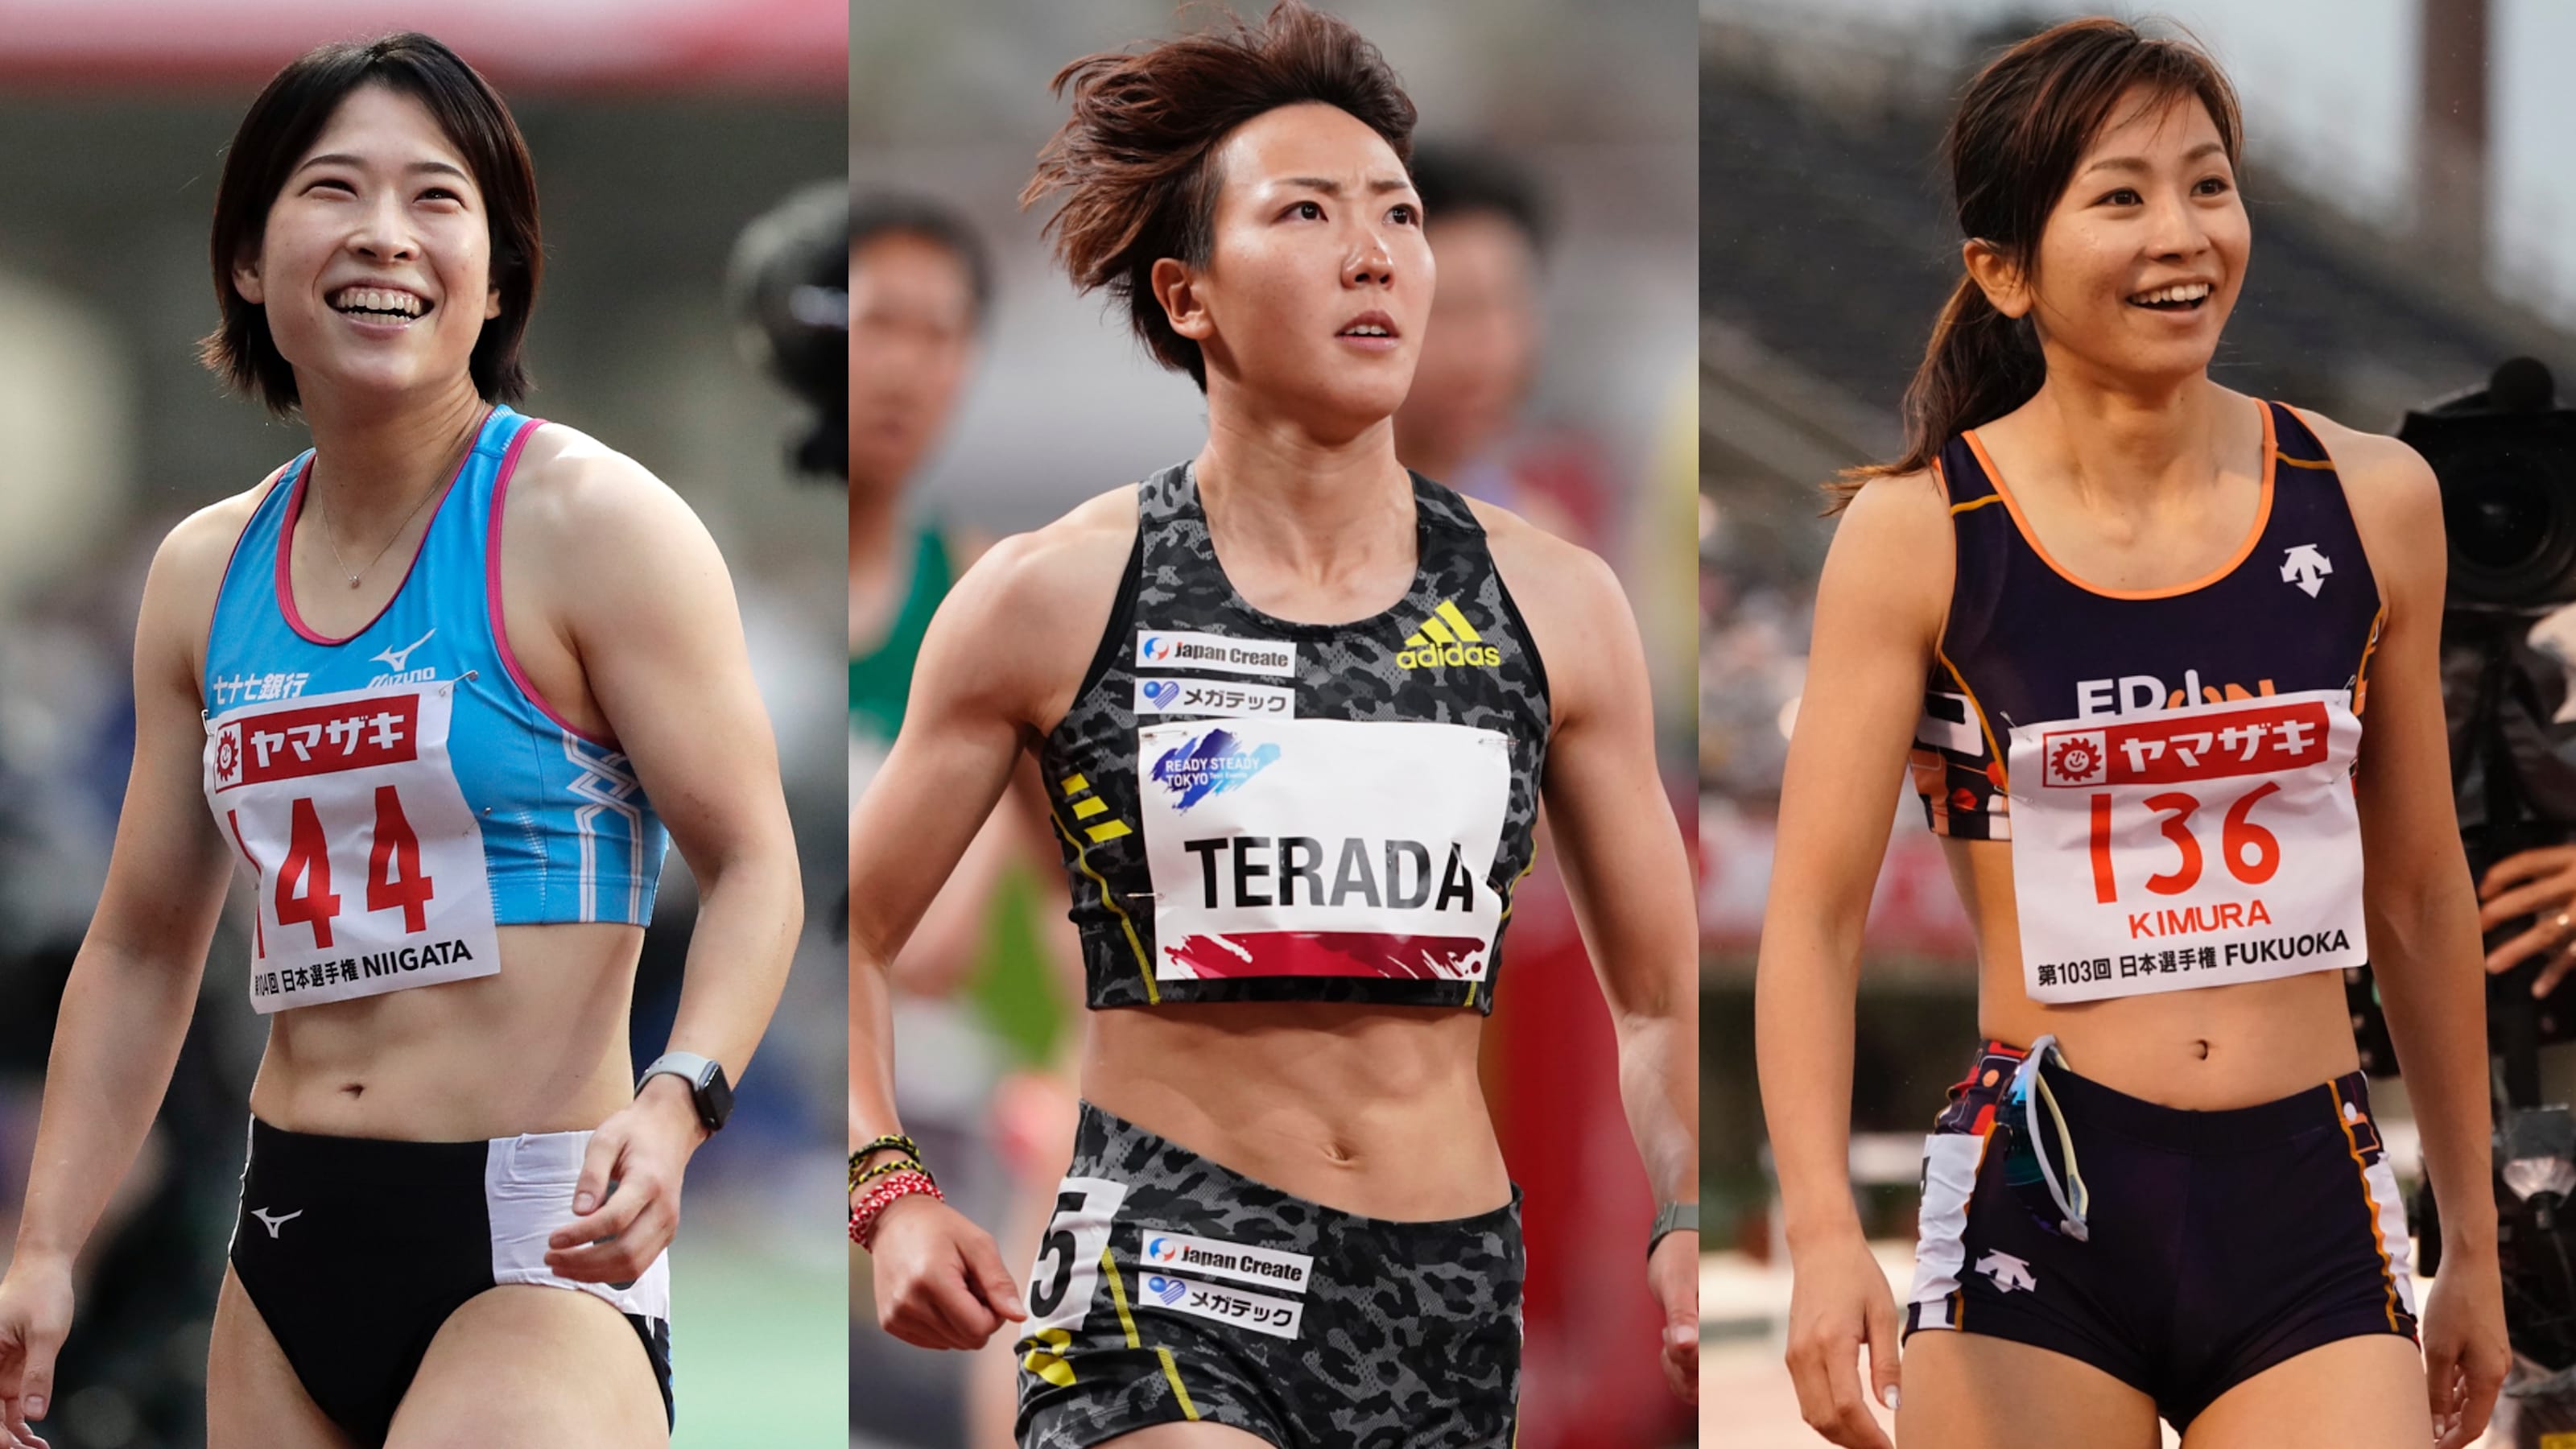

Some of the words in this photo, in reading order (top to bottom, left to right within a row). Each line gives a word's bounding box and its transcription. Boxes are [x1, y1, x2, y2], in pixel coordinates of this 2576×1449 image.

[1174, 642, 1226, 662] Japan
[1229, 647, 1288, 667] Create
[1397, 641, 1501, 669] adidas
[213, 672, 310, 705] 七十七銀行
[1184, 688, 1286, 712] メガテック
[250, 712, 404, 768] ヤマザキ
[2120, 720, 2316, 773] ヤマザキ
[1165, 758, 1208, 772] READY
[1210, 757, 1260, 770] STEADY
[1166, 772, 1208, 787] TOKYO
[2090, 781, 2281, 904] 136
[1184, 836, 1475, 912] TERADA
[2129, 899, 2272, 939] KIMURA
[282, 959, 359, 992] 日本選手権
[362, 939, 473, 978] NIIGATA
[2038, 959, 2112, 987] 第103回
[2120, 947, 2218, 979] 日本選手権
[2224, 929, 2350, 967] FUKUOKA
[1030, 1192, 1088, 1318] 5
[1181, 1245, 1236, 1270] Japan
[1240, 1256, 1302, 1282] Create
[1190, 1292, 1293, 1327] メガテック
